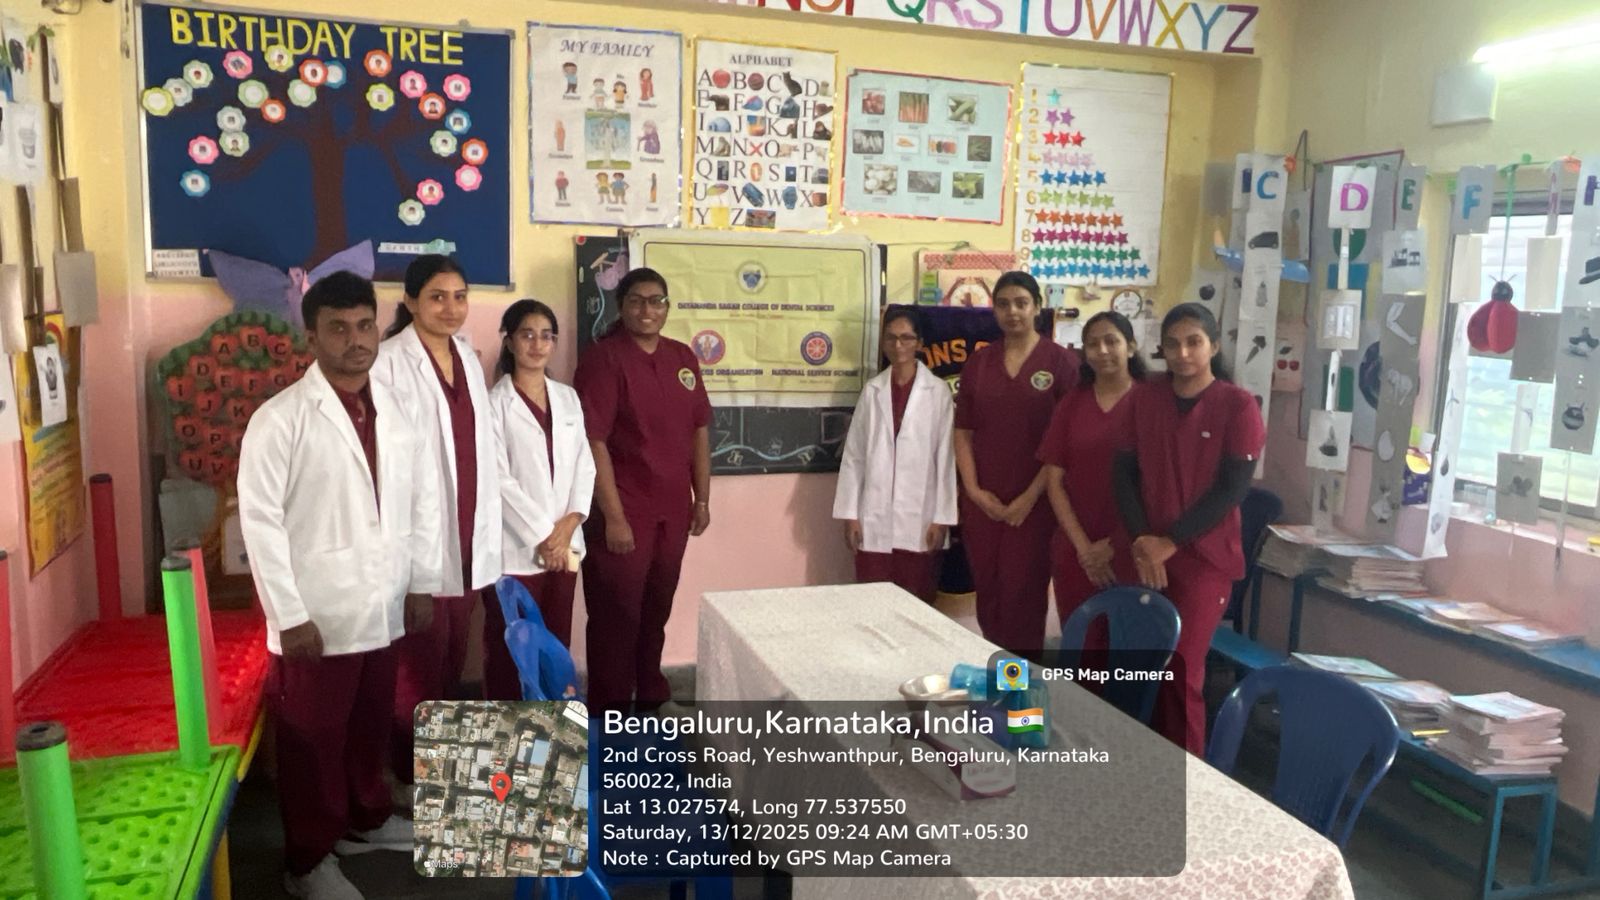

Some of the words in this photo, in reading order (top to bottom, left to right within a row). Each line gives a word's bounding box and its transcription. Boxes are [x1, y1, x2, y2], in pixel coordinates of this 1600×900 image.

[169, 8, 356, 59] BIRTHDAY
[380, 26, 464, 65] TREE
[560, 39, 589, 53] MY
[590, 42, 655, 58] FAMILY
[729, 55, 794, 67] ALPHABET
[698, 69, 713, 87] A
[733, 71, 747, 90] B
[767, 74, 782, 94] C
[805, 79, 819, 97] D
[697, 90, 710, 108] E
[733, 93, 745, 112] F
[765, 96, 782, 115] G
[1029, 108, 1039, 124] 2
[735, 115, 742, 133] J
[767, 118, 784, 137] K
[802, 121, 814, 139] L
[1028, 131, 1038, 144] 3
[697, 136, 714, 155] M
[733, 138, 748, 156] N
[764, 139, 780, 158] O
[802, 143, 814, 160] P
[1028, 148, 1041, 164] 4
[696, 158, 713, 181] Q
[733, 160, 746, 179] R
[769, 163, 780, 182] S
[800, 165, 813, 182] T
[1027, 170, 1038, 184] 5
[1256, 170, 1280, 200] C
[1401, 178, 1416, 211] E
[693, 183, 707, 201] U
[766, 188, 783, 207] W
[800, 190, 814, 207] X
[1026, 190, 1037, 205] 6
[1339, 182, 1369, 212] D
[1462, 184, 1483, 220] F
[695, 207, 710, 225] Y
[731, 208, 745, 226] Z
[1025, 209, 1035, 224] 7
[1021, 229, 1031, 243] 8
[1020, 247, 1030, 261] 9
[770, 303, 779, 311] OF
[806, 304, 835, 312] SCIENCES
[219, 343, 230, 355] A
[247, 334, 260, 348] B
[275, 343, 286, 355] C
[197, 363, 209, 375] D
[220, 375, 231, 388] E
[771, 368, 805, 377] NATIONAL
[807, 369, 832, 377] SERVICE
[201, 399, 212, 412] J
[233, 405, 246, 417] K
[181, 424, 196, 437] O
[210, 433, 221, 444] P
[211, 462, 224, 475] V
